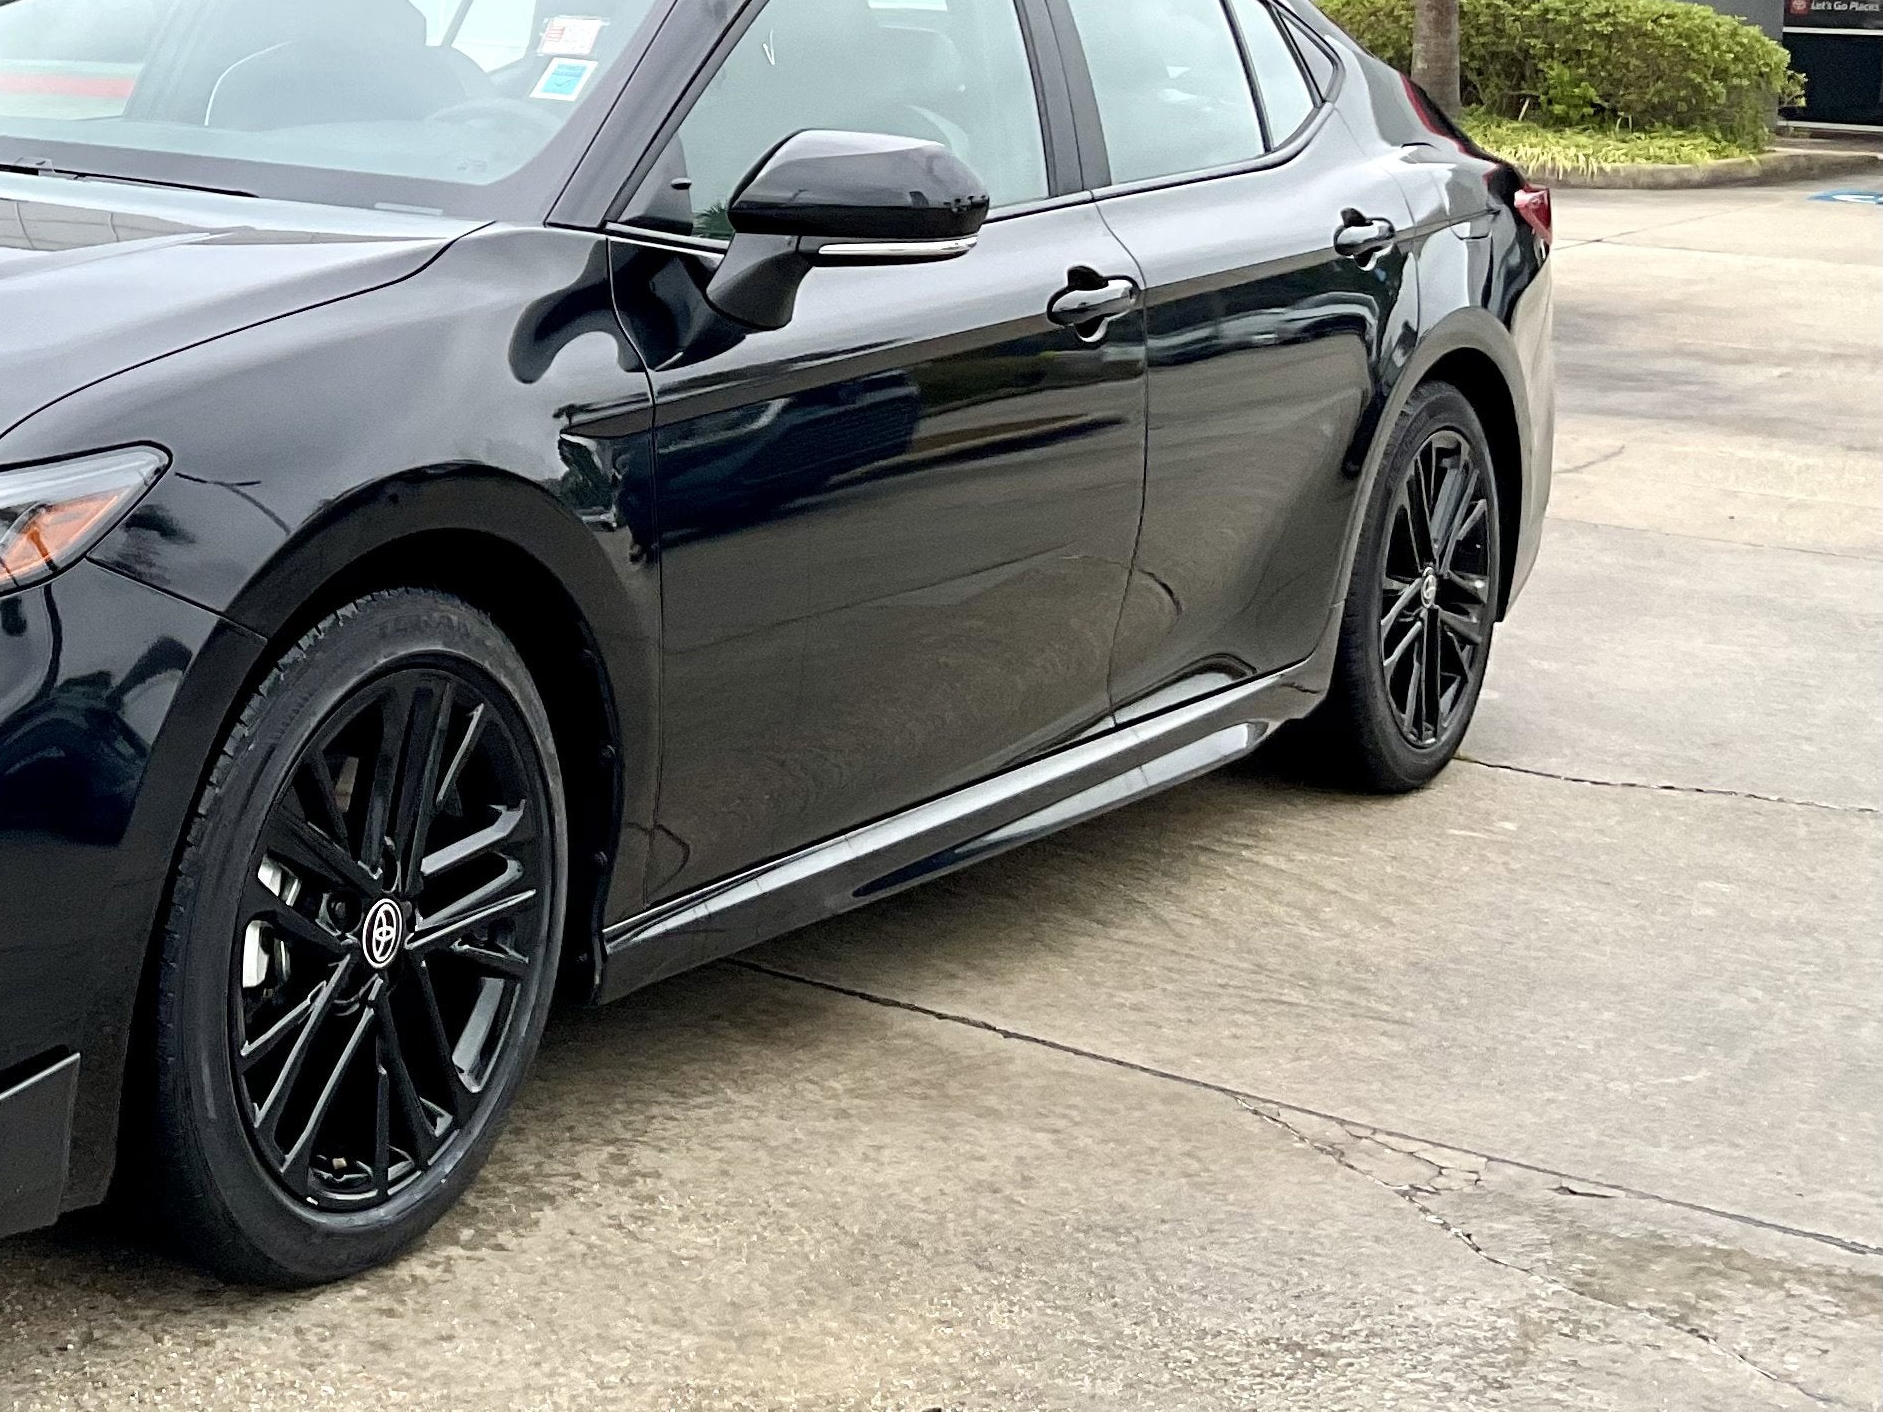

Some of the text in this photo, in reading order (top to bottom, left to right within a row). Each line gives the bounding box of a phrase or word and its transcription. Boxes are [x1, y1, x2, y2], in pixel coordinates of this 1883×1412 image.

[1811, 0, 1880, 12] Let's Go Places
